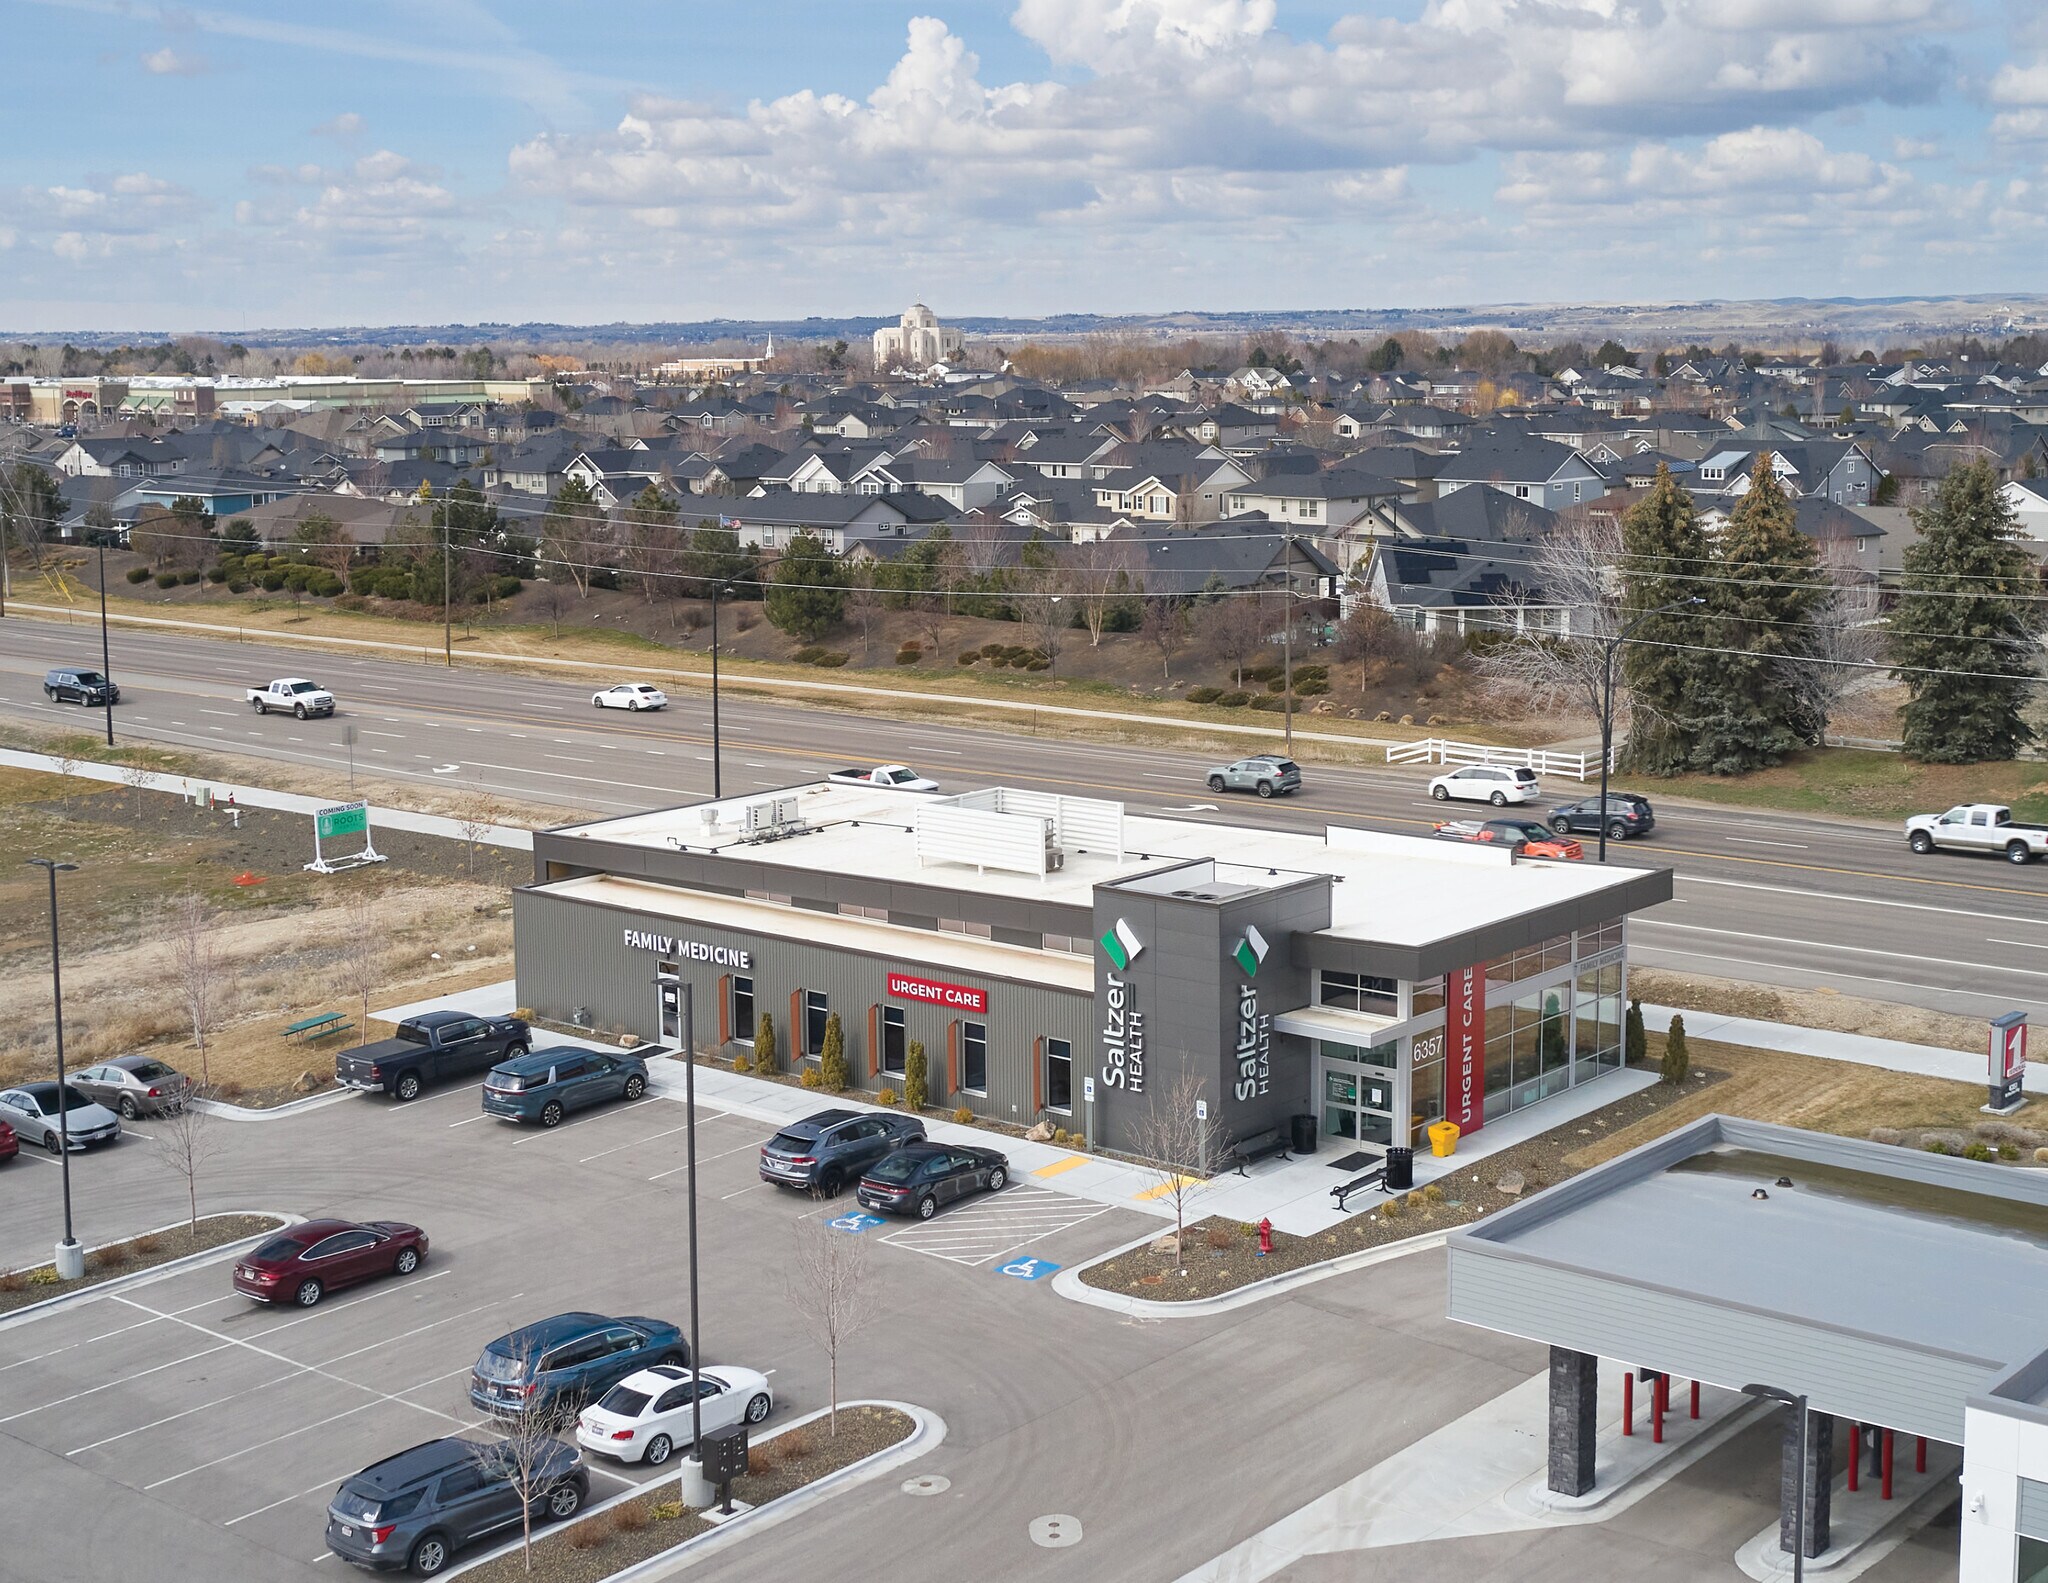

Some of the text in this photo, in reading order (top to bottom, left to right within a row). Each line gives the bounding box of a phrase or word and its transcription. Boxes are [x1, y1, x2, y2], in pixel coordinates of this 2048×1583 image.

[319, 802, 363, 815] COMING SOON
[334, 813, 364, 825] ROOTS
[624, 929, 749, 969] FAMILY MEDICINE
[891, 979, 980, 1007] URGENT CARE
[1103, 973, 1125, 1089] Saltzer
[1129, 1012, 1143, 1092] HEALTH
[1235, 985, 1257, 1101] Saltzer
[1259, 1013, 1270, 1095] HEALTH
[1413, 1034, 1443, 1062] 6357
[1462, 967, 1473, 1123] URGENT CARE
